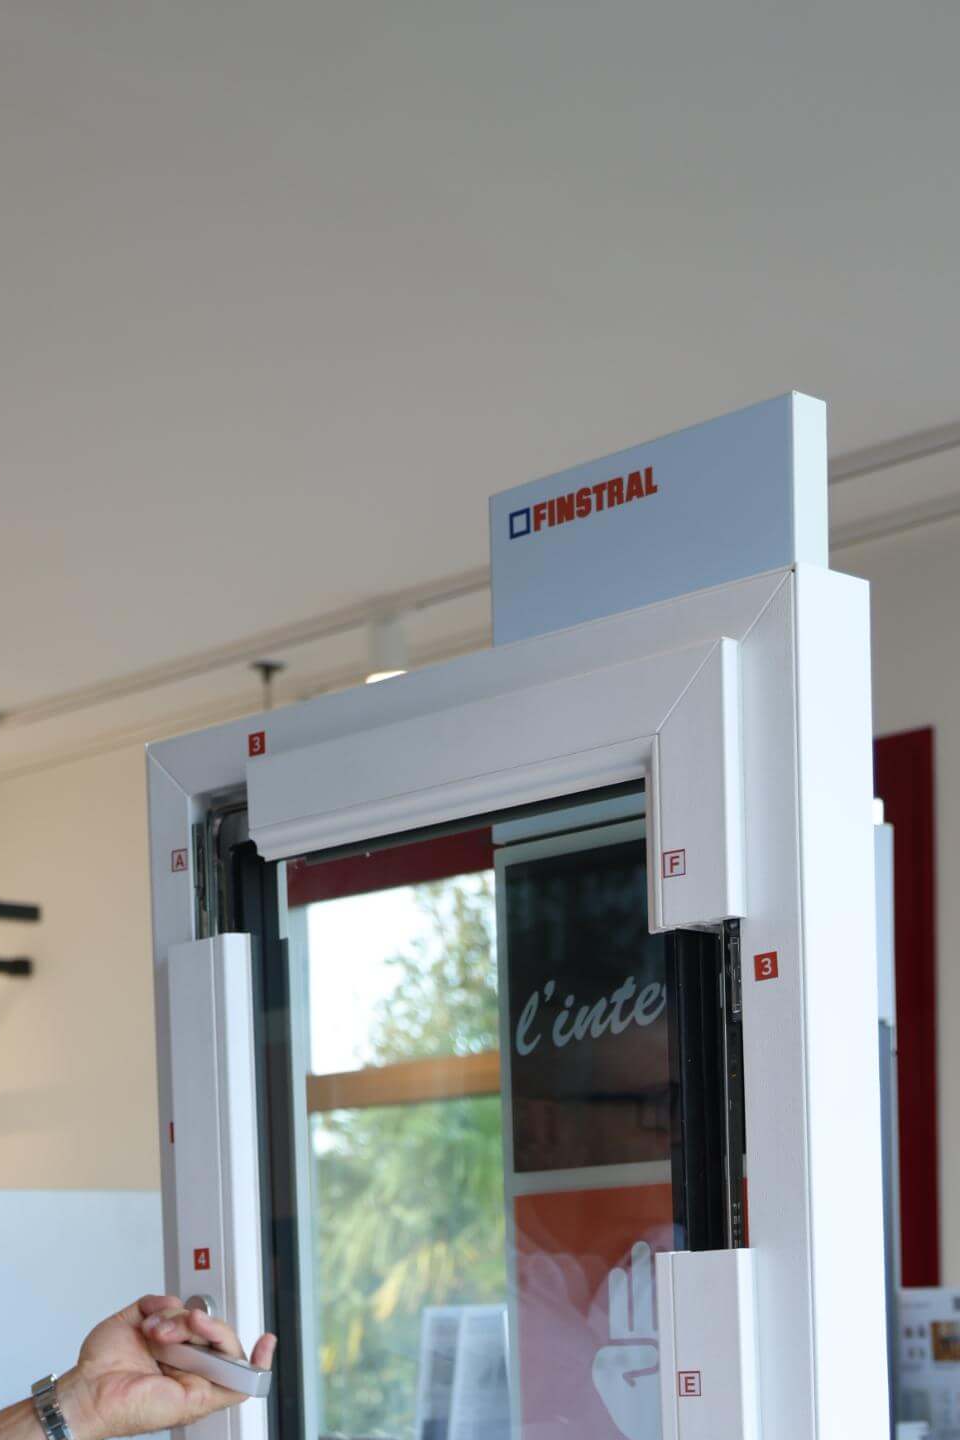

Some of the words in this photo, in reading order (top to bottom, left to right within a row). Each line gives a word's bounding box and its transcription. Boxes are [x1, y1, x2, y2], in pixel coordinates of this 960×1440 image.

[533, 466, 658, 532] FINSTRAL
[760, 957, 772, 976] 3
[515, 975, 667, 1057] l'inte
